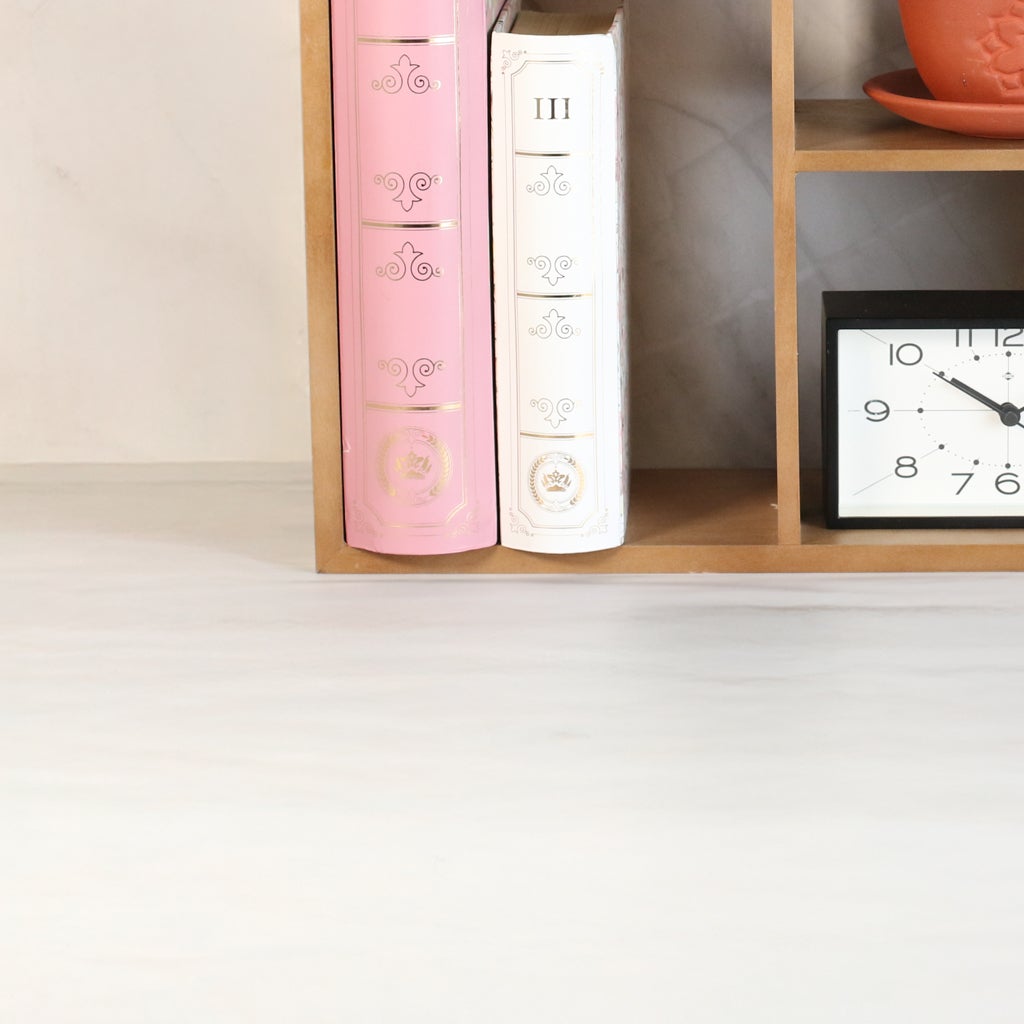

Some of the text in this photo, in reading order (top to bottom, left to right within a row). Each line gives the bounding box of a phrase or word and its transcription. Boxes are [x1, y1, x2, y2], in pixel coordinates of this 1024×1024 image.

[533, 97, 571, 120] III
[955, 328, 973, 348] 11
[994, 328, 1024, 348] 12
[889, 342, 924, 366] 10
[863, 399, 891, 422] 9
[894, 455, 919, 479] 8
[951, 472, 975, 496] 7
[994, 472, 1021, 495] 6
